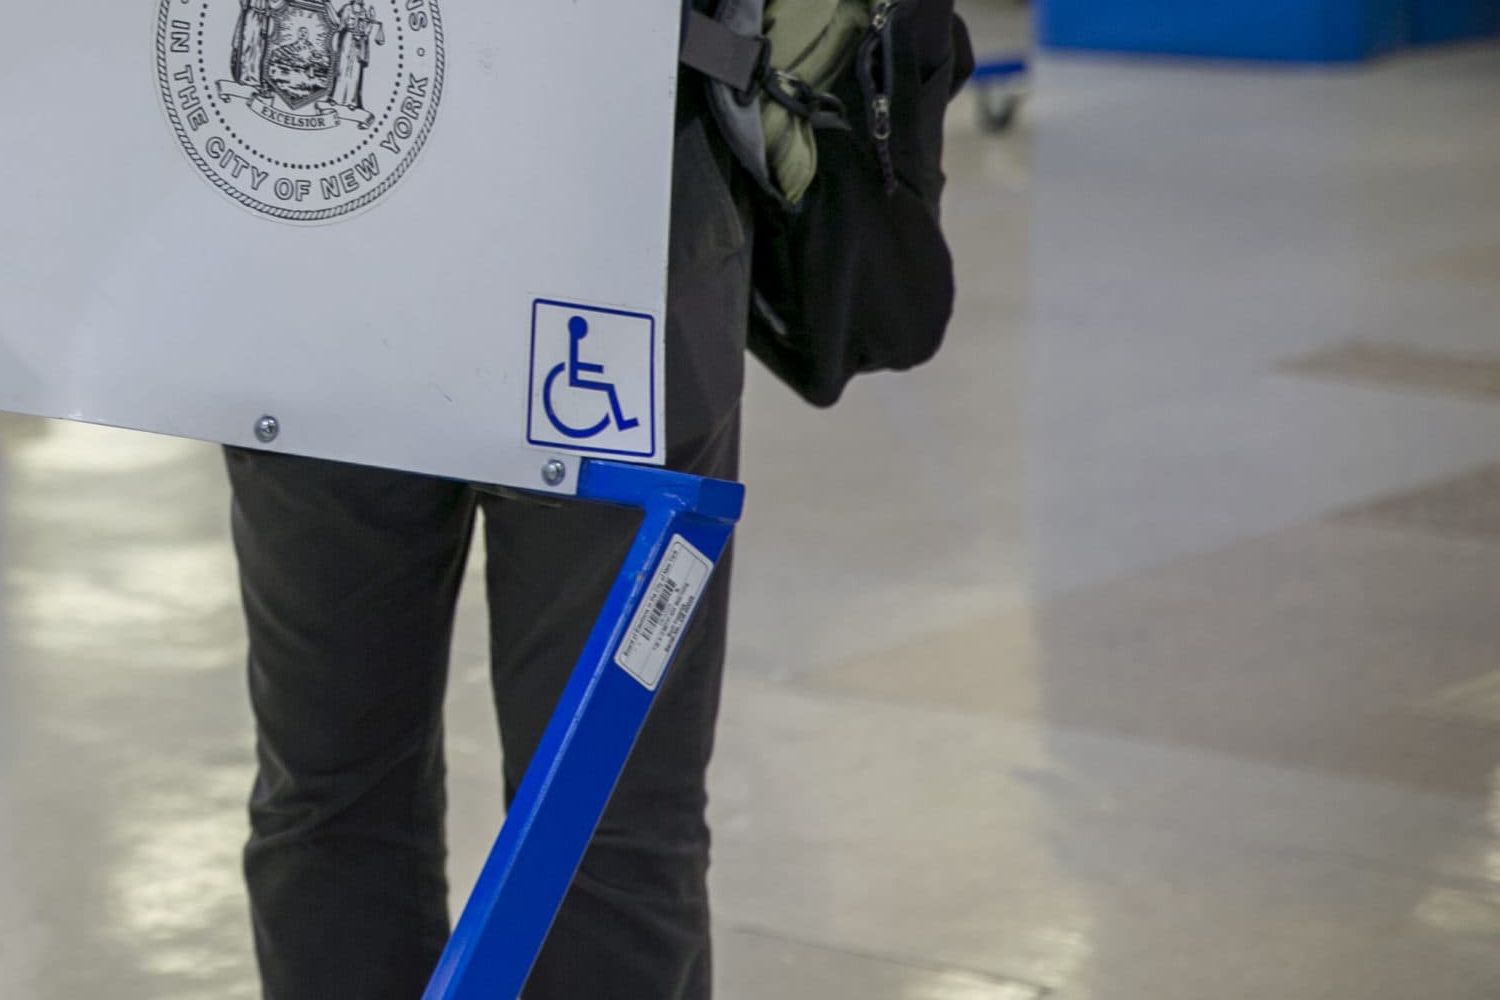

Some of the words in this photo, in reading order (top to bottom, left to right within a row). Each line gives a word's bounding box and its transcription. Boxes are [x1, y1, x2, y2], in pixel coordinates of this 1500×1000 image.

[170, 19, 191, 53] IN
[173, 64, 209, 132] THE
[261, 106, 325, 128] EXCELSIOR
[380, 72, 429, 155] YORK
[205, 136, 269, 191] CITY
[319, 152, 381, 201] NEW
[274, 177, 311, 201] OF
